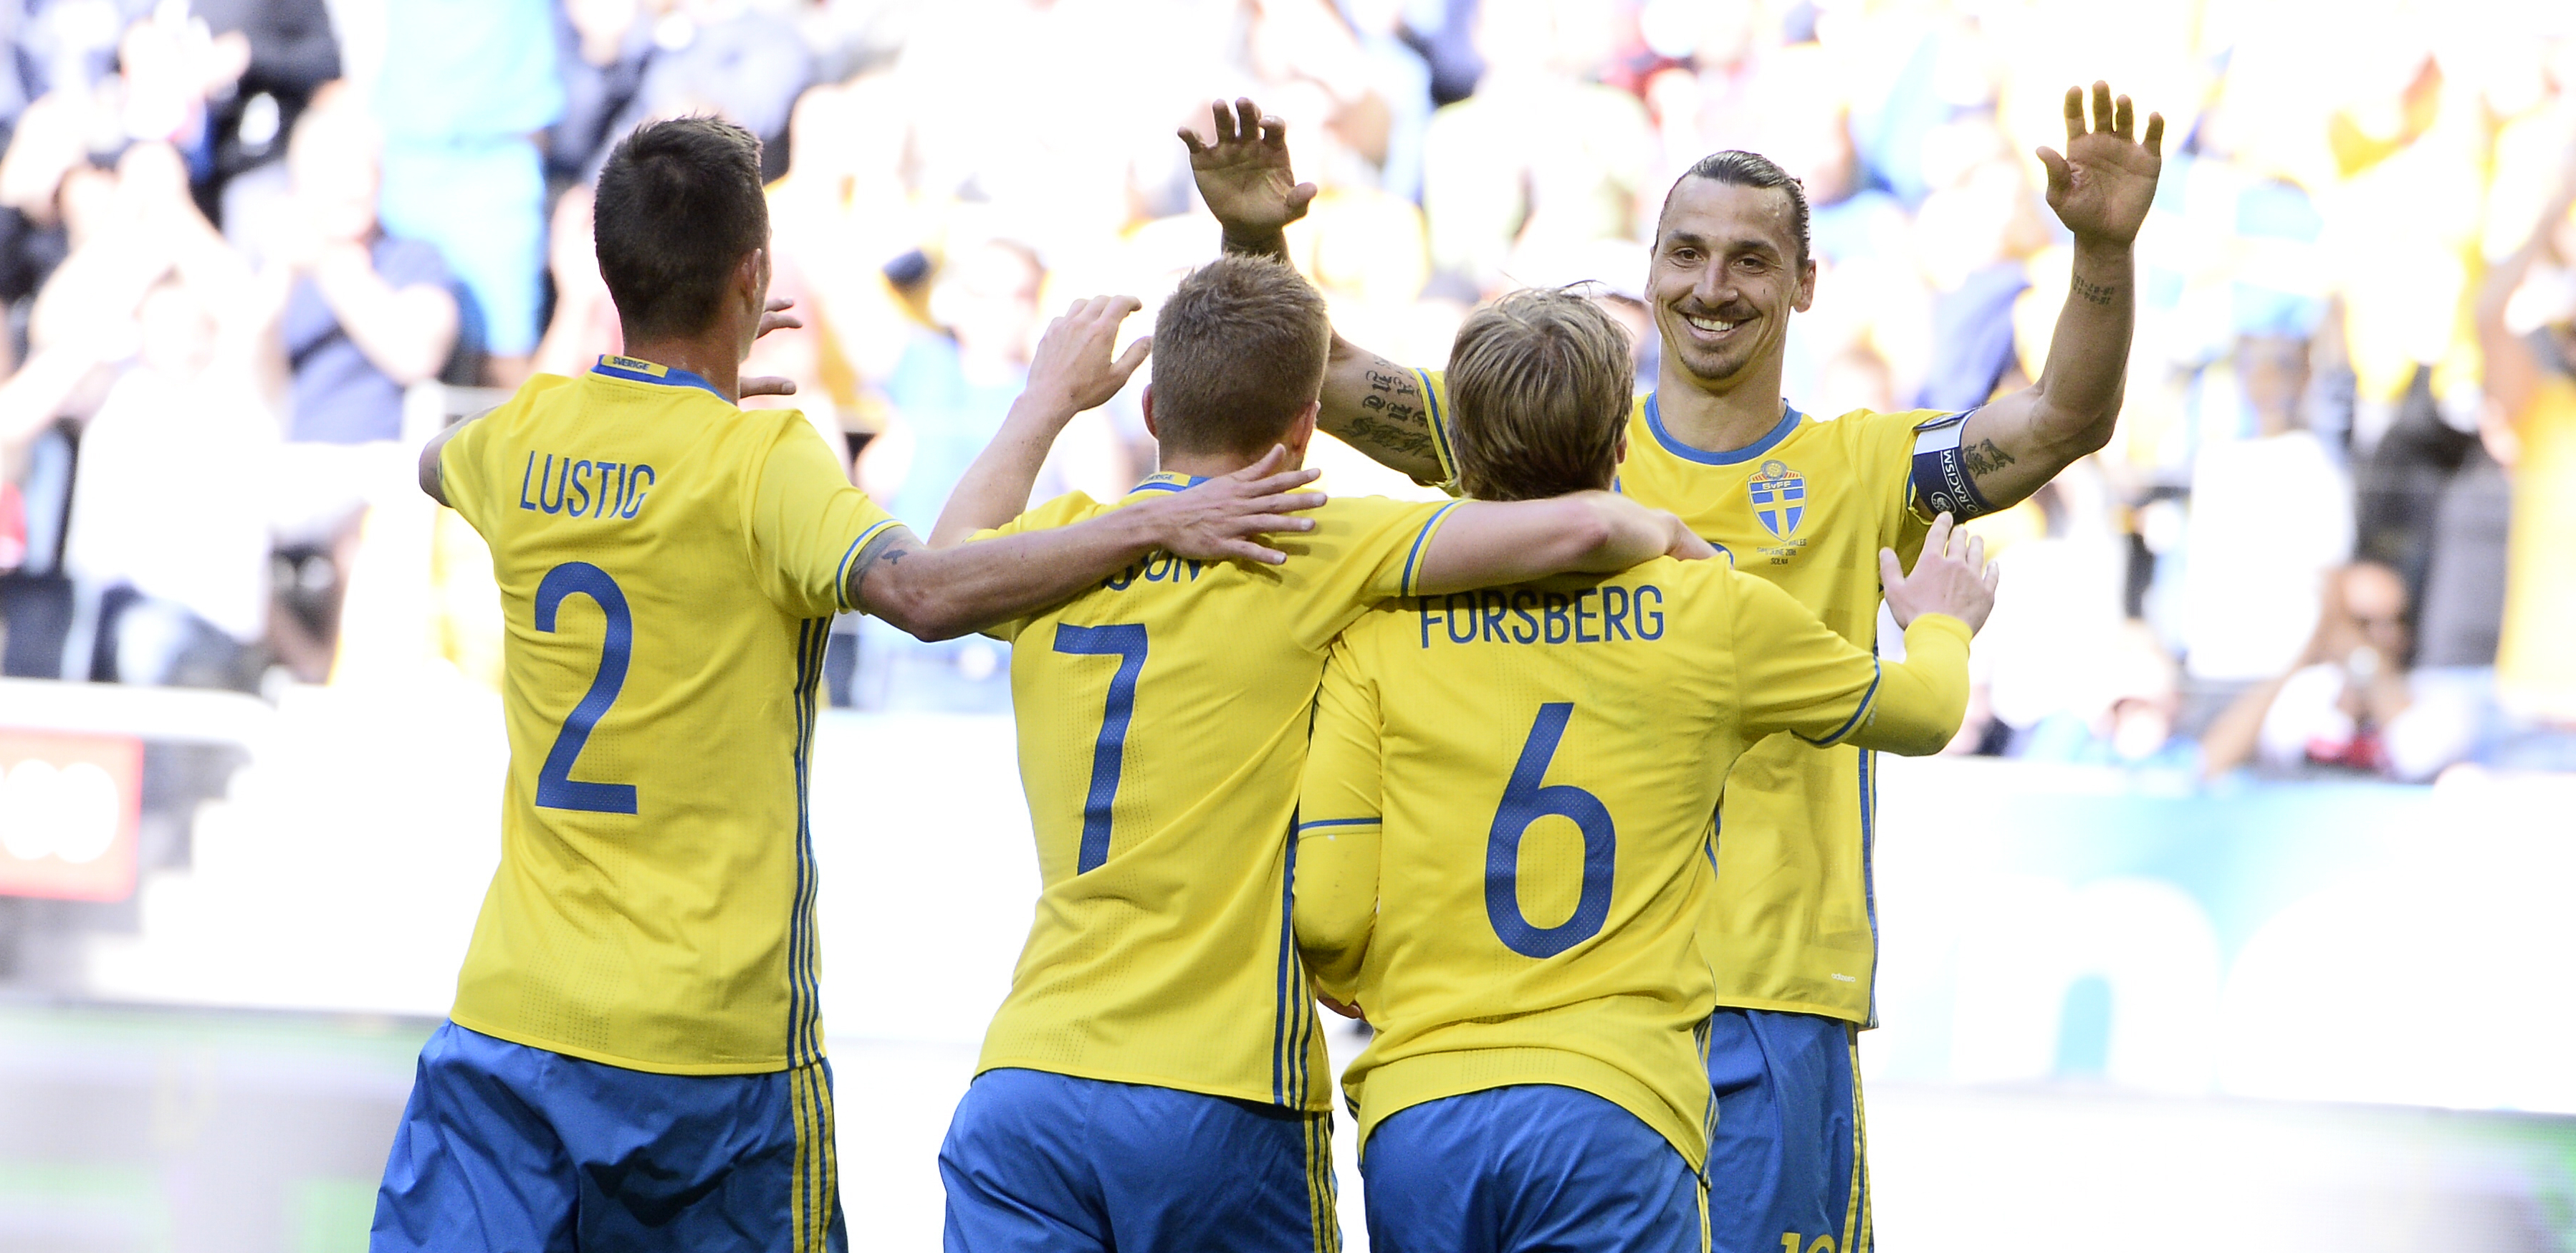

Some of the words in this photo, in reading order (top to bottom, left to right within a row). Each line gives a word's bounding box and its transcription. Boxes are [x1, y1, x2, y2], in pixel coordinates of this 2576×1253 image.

[613, 357, 650, 370] SVERIGE
[520, 451, 656, 519] LUSTIG
[1943, 449, 1970, 503] RACISM
[1419, 585, 1665, 649] FORSBERG
[534, 561, 638, 815] 2
[1053, 623, 1149, 876] 7
[1485, 702, 1617, 959] 6
